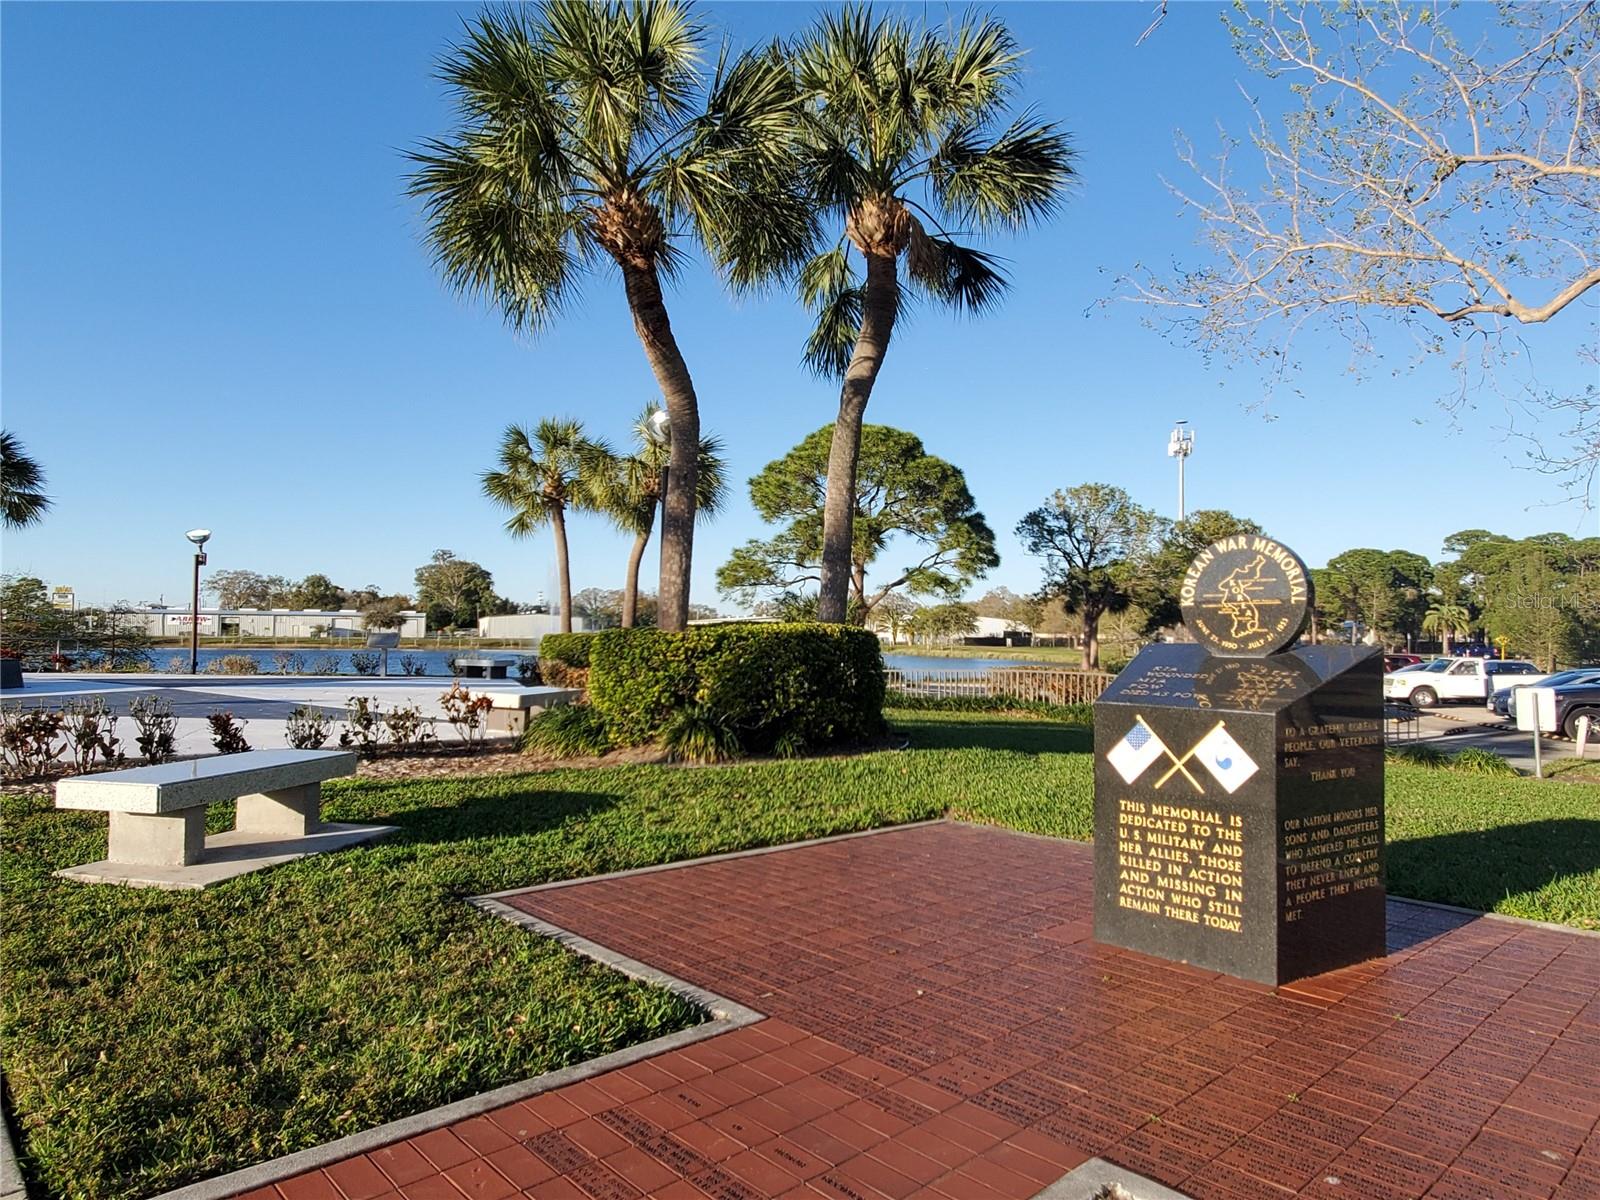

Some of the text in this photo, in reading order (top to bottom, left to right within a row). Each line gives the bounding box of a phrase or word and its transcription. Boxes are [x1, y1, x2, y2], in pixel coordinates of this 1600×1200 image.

[1180, 536, 1308, 607] KOREAN WAR MEMORIAL
[1247, 638, 1265, 650] JULY
[1146, 671, 1209, 680] WOUNDED
[1119, 689, 1151, 697] DIED
[1319, 739, 1336, 750] OUR
[1340, 735, 1378, 747] VETERANS
[1311, 767, 1356, 782] THANK YOU
[1120, 799, 1243, 827] THIS MEMORIAL IS
[1284, 806, 1378, 831] OUR NATION HONORS HER
[1120, 813, 1243, 842] DEDICATED TO THE
[1284, 820, 1379, 846] SONS AND DAUGHTERS
[1120, 841, 1143, 855] HER
[1199, 855, 1243, 872] THOSE
[1147, 832, 1205, 851] MILITARY
[1212, 843, 1243, 857] AND
[1284, 834, 1379, 860] WHO ANSWERED THE CALL
[1120, 855, 1243, 887] KILLED IN ACTION
[1285, 848, 1378, 876] TO DEFEND A COUNTRY
[1120, 870, 1243, 902] AND MISSING IN
[1286, 878, 1306, 891] THEY
[1310, 872, 1336, 886] NEVER
[1363, 862, 1380, 874] AND
[1120, 883, 1243, 918] ACTION WHO STILL
[1285, 877, 1379, 907] A PEOPLE THEY NEVER
[1120, 896, 1243, 933] REMAIN THERE TODAY.
